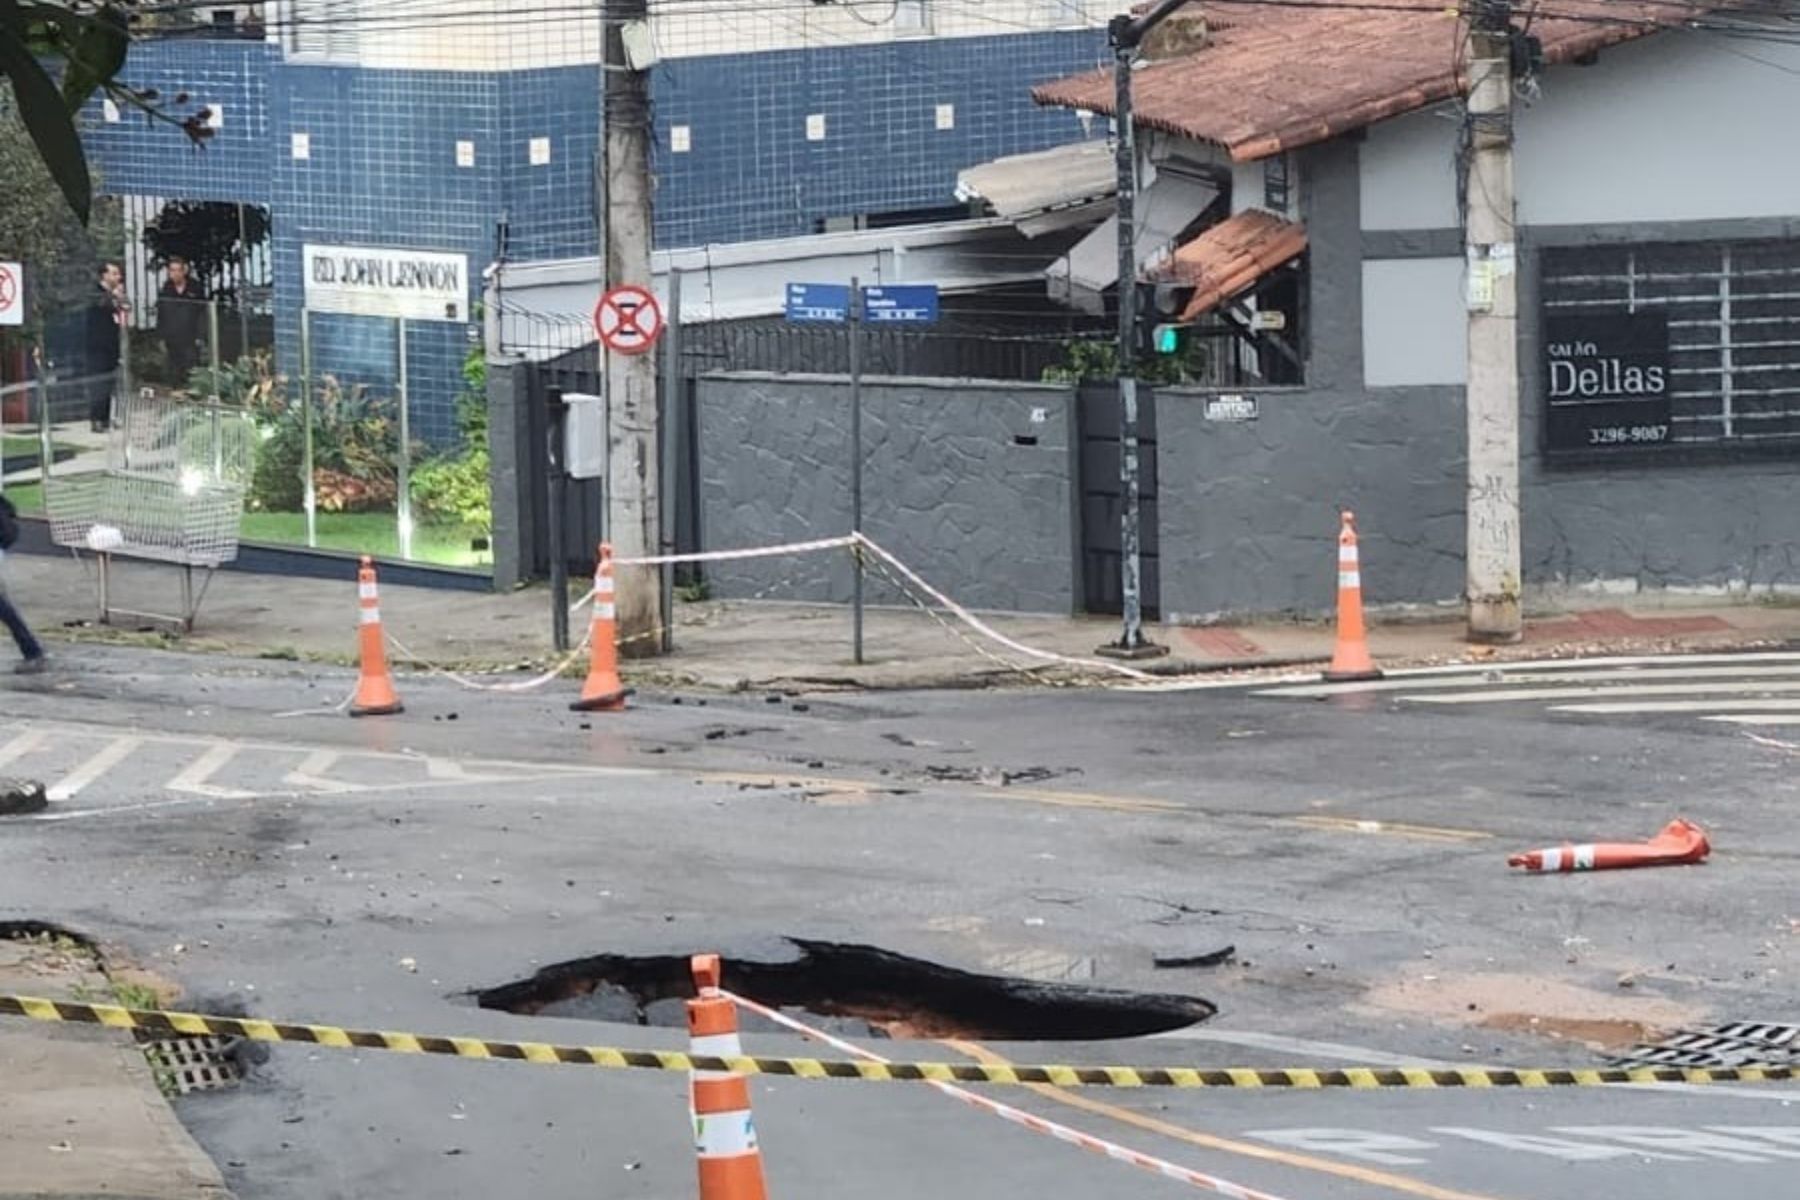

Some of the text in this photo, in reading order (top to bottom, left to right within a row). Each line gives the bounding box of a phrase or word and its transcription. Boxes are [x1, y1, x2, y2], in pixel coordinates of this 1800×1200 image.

[341, 257, 383, 287] JOHN
[388, 260, 459, 292] LENNON
[1549, 359, 1665, 396] Dellas
